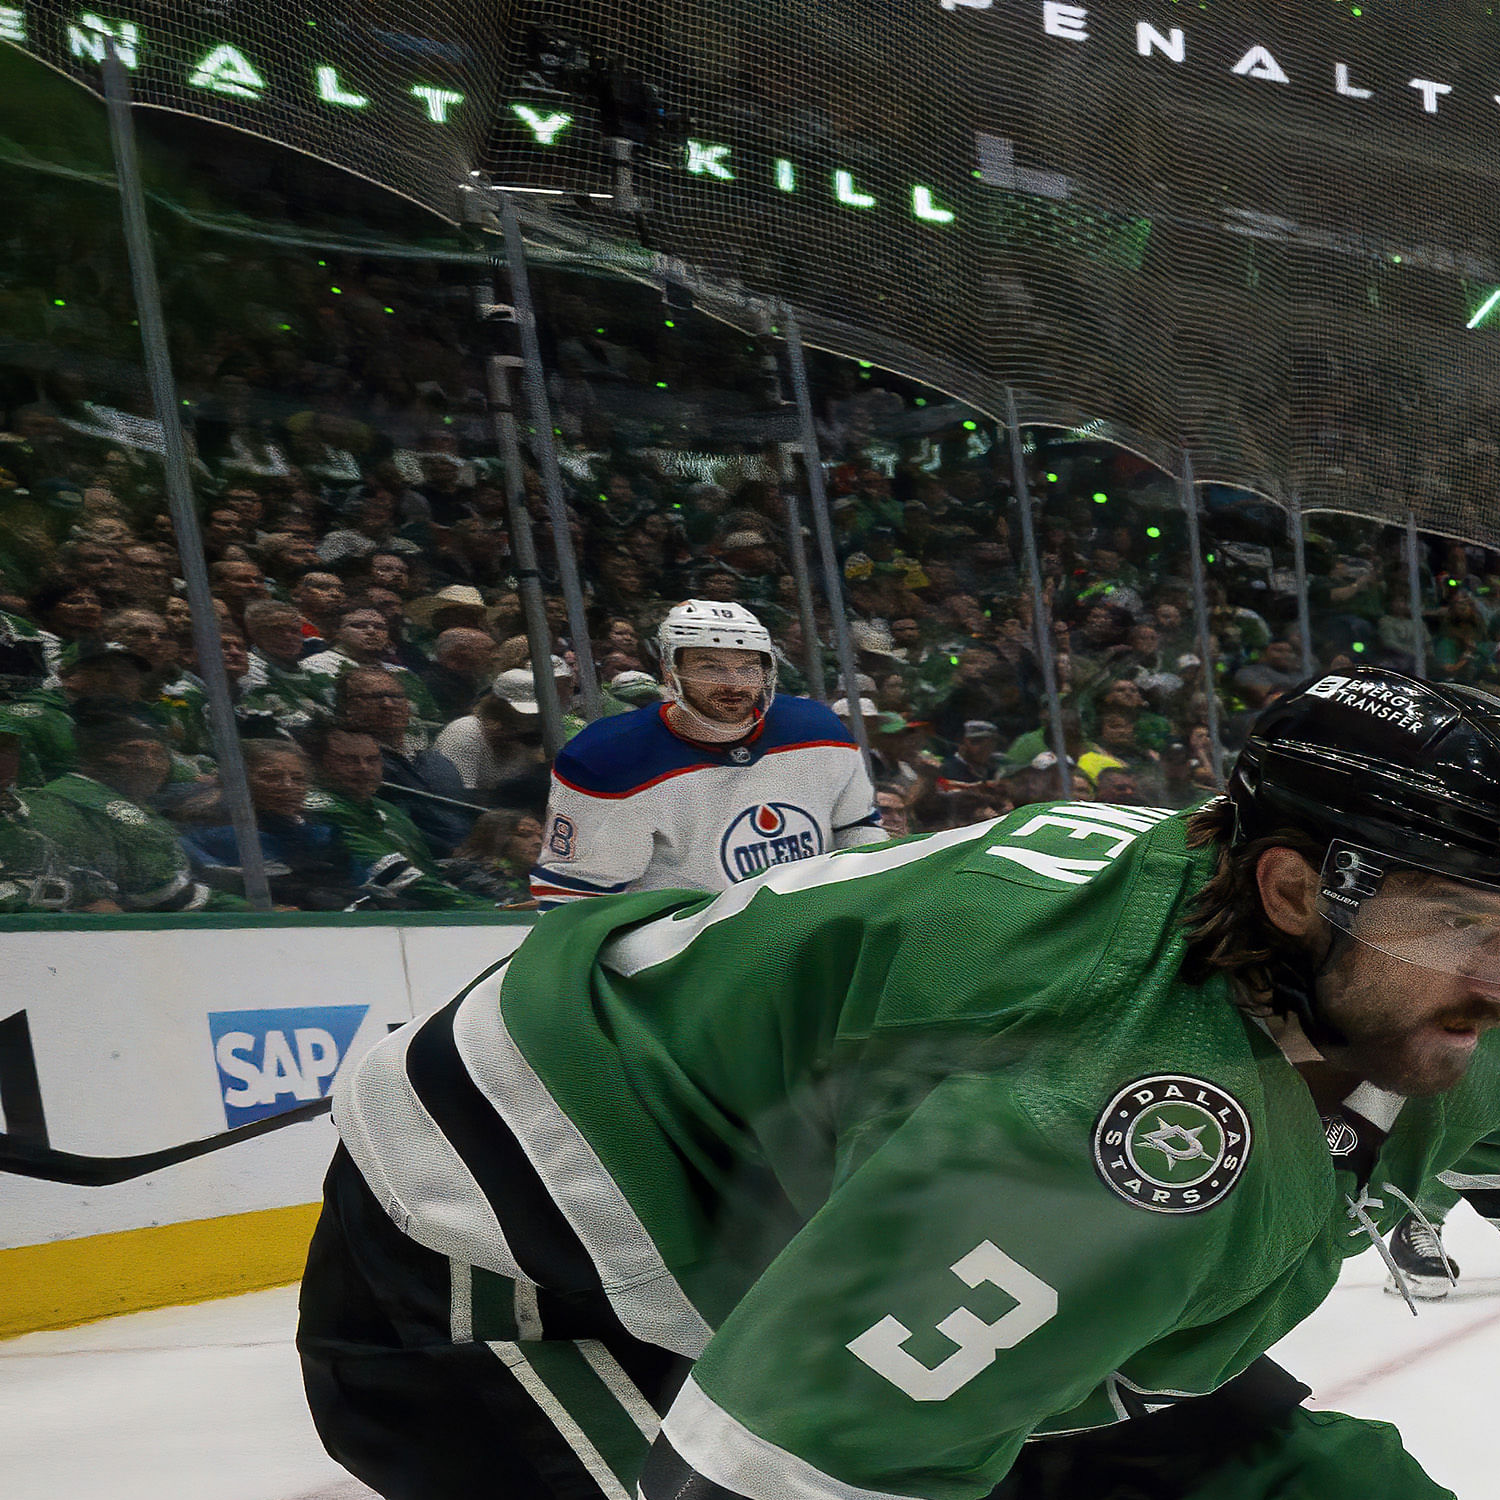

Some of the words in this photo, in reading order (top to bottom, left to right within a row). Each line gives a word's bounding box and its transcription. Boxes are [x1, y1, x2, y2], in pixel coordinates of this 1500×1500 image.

[685, 136, 957, 224] KILL
[1335, 688, 1424, 736] TRANSFER
[215, 1026, 340, 1109] SAP
[1104, 1129, 1202, 1205] STARS
[1132, 1084, 1243, 1172] DALLAS
[1326, 1121, 1343, 1149] NHL
[844, 1238, 1059, 1402] 3
